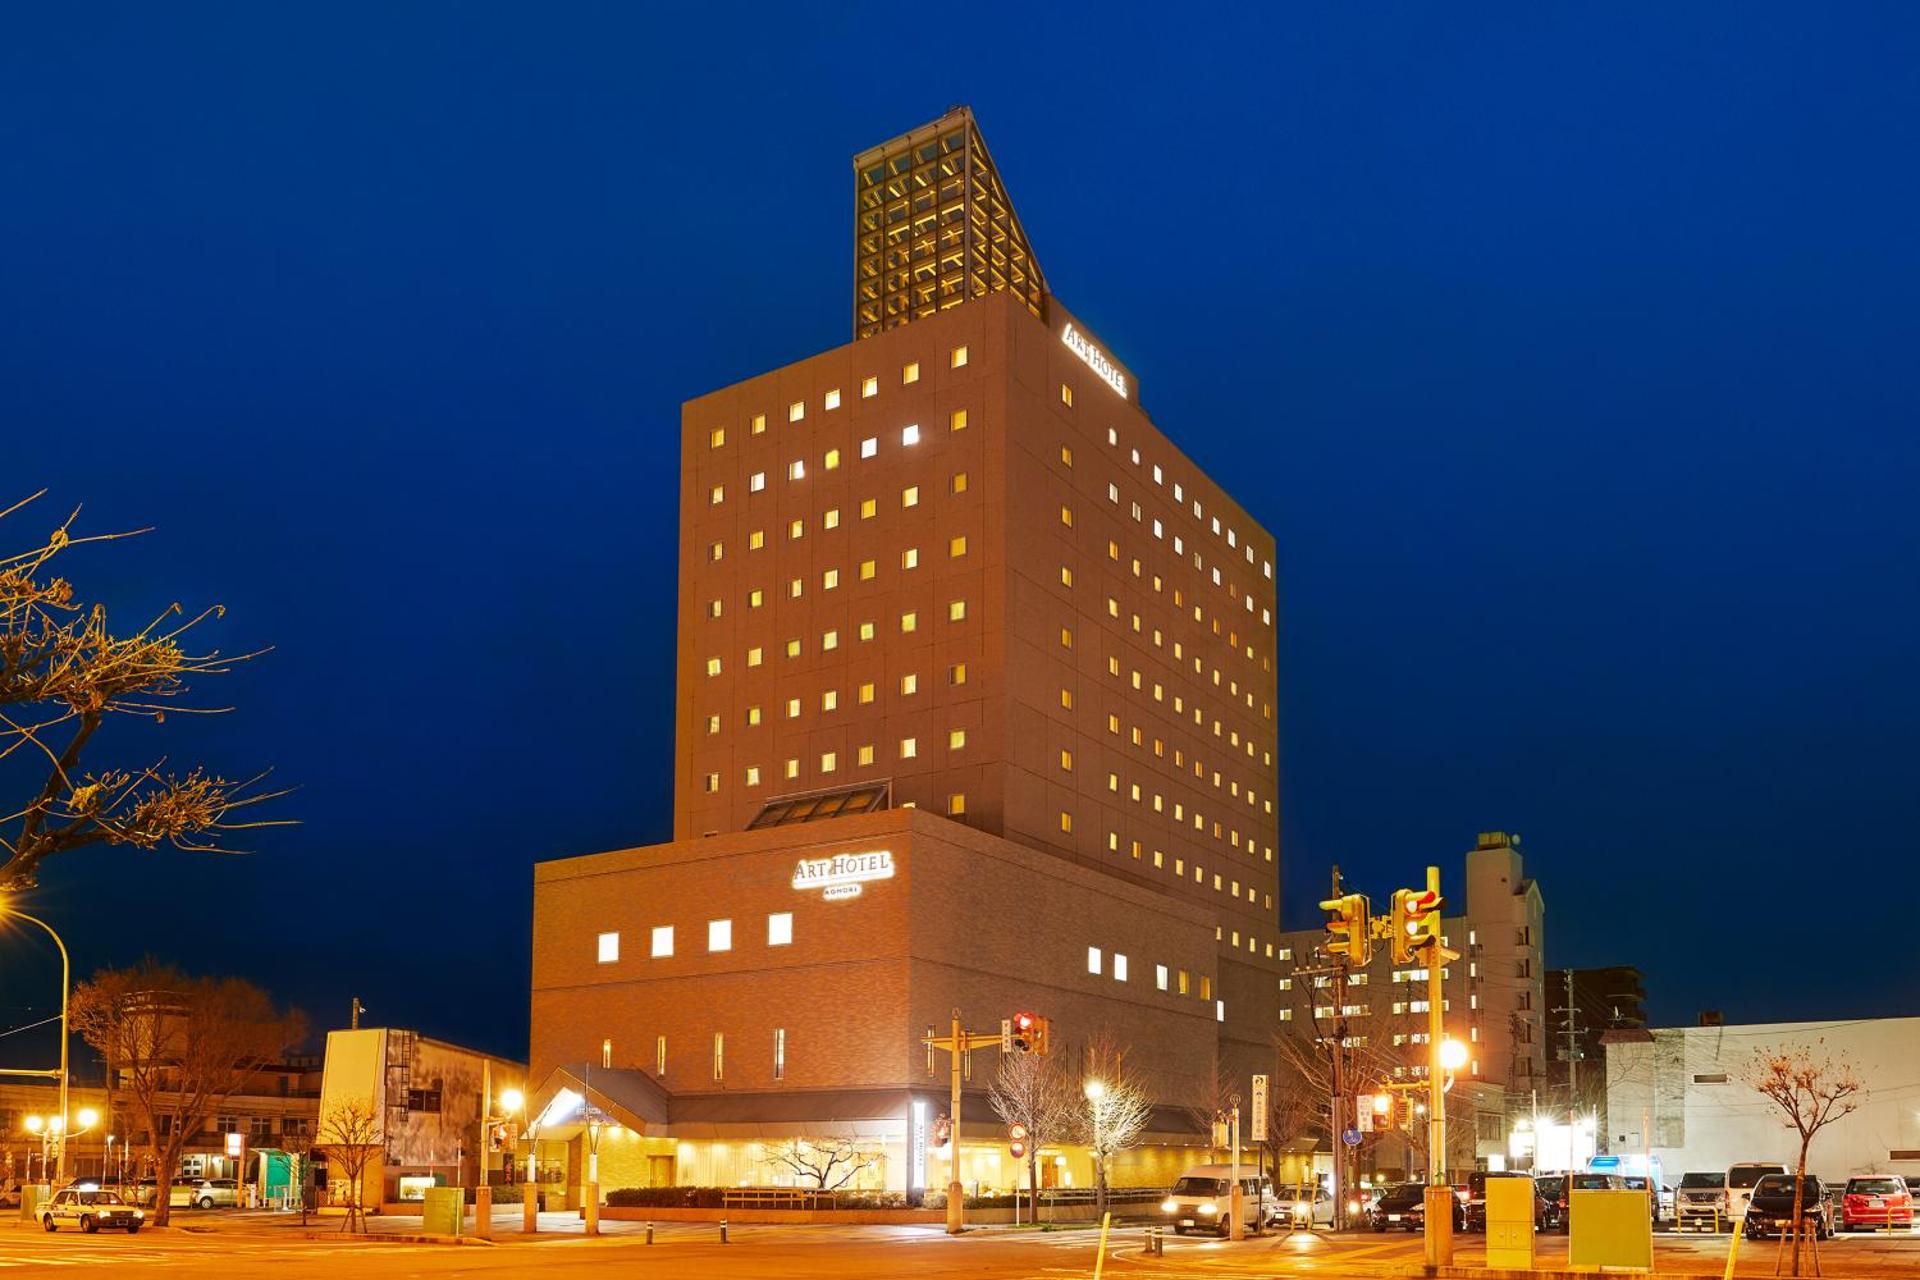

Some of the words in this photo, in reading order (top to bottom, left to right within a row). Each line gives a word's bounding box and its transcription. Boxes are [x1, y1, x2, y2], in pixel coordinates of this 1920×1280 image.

[1066, 327, 1088, 357] ART
[1092, 347, 1128, 393] HOTEL
[794, 862, 826, 879] ART
[832, 855, 889, 874] HOTEL
